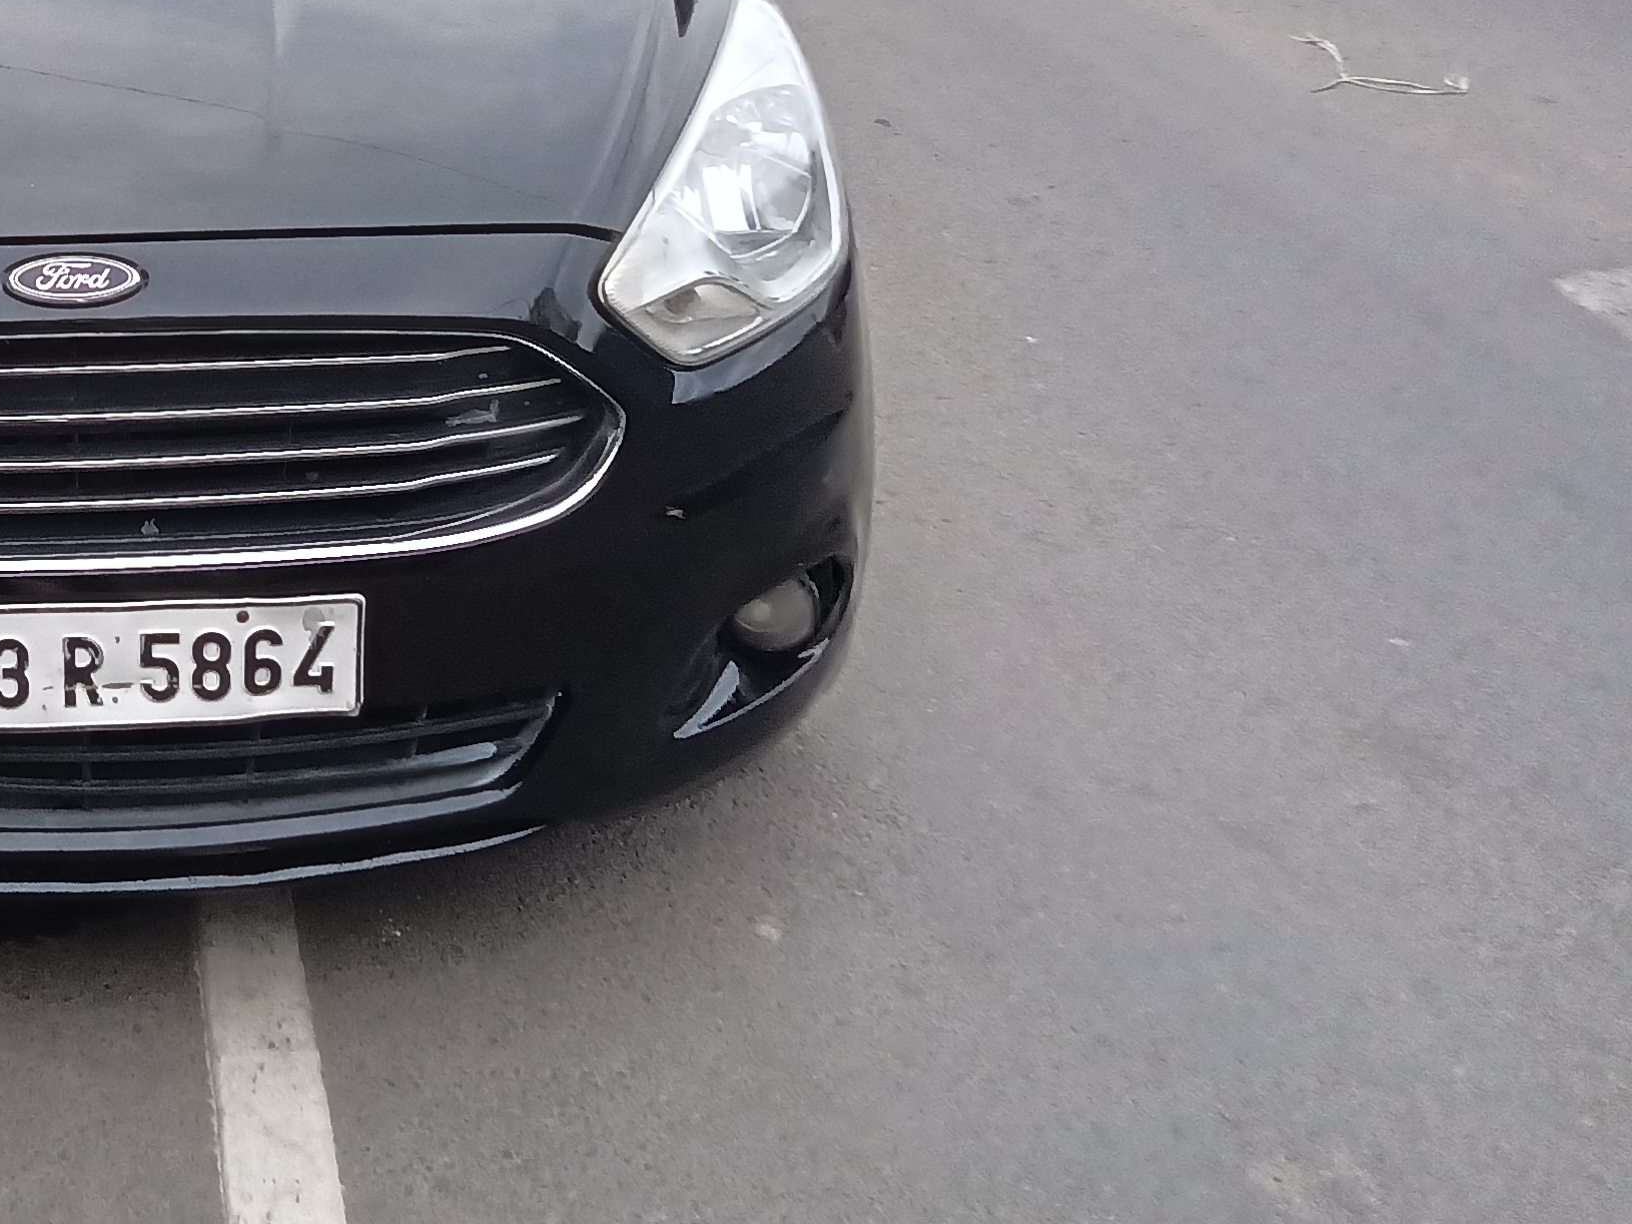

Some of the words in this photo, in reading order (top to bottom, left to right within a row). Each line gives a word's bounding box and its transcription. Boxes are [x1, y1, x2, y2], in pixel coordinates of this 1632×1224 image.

[35, 262, 111, 290] Ford
[62, 636, 104, 708] R
[138, 623, 335, 703] 5864
